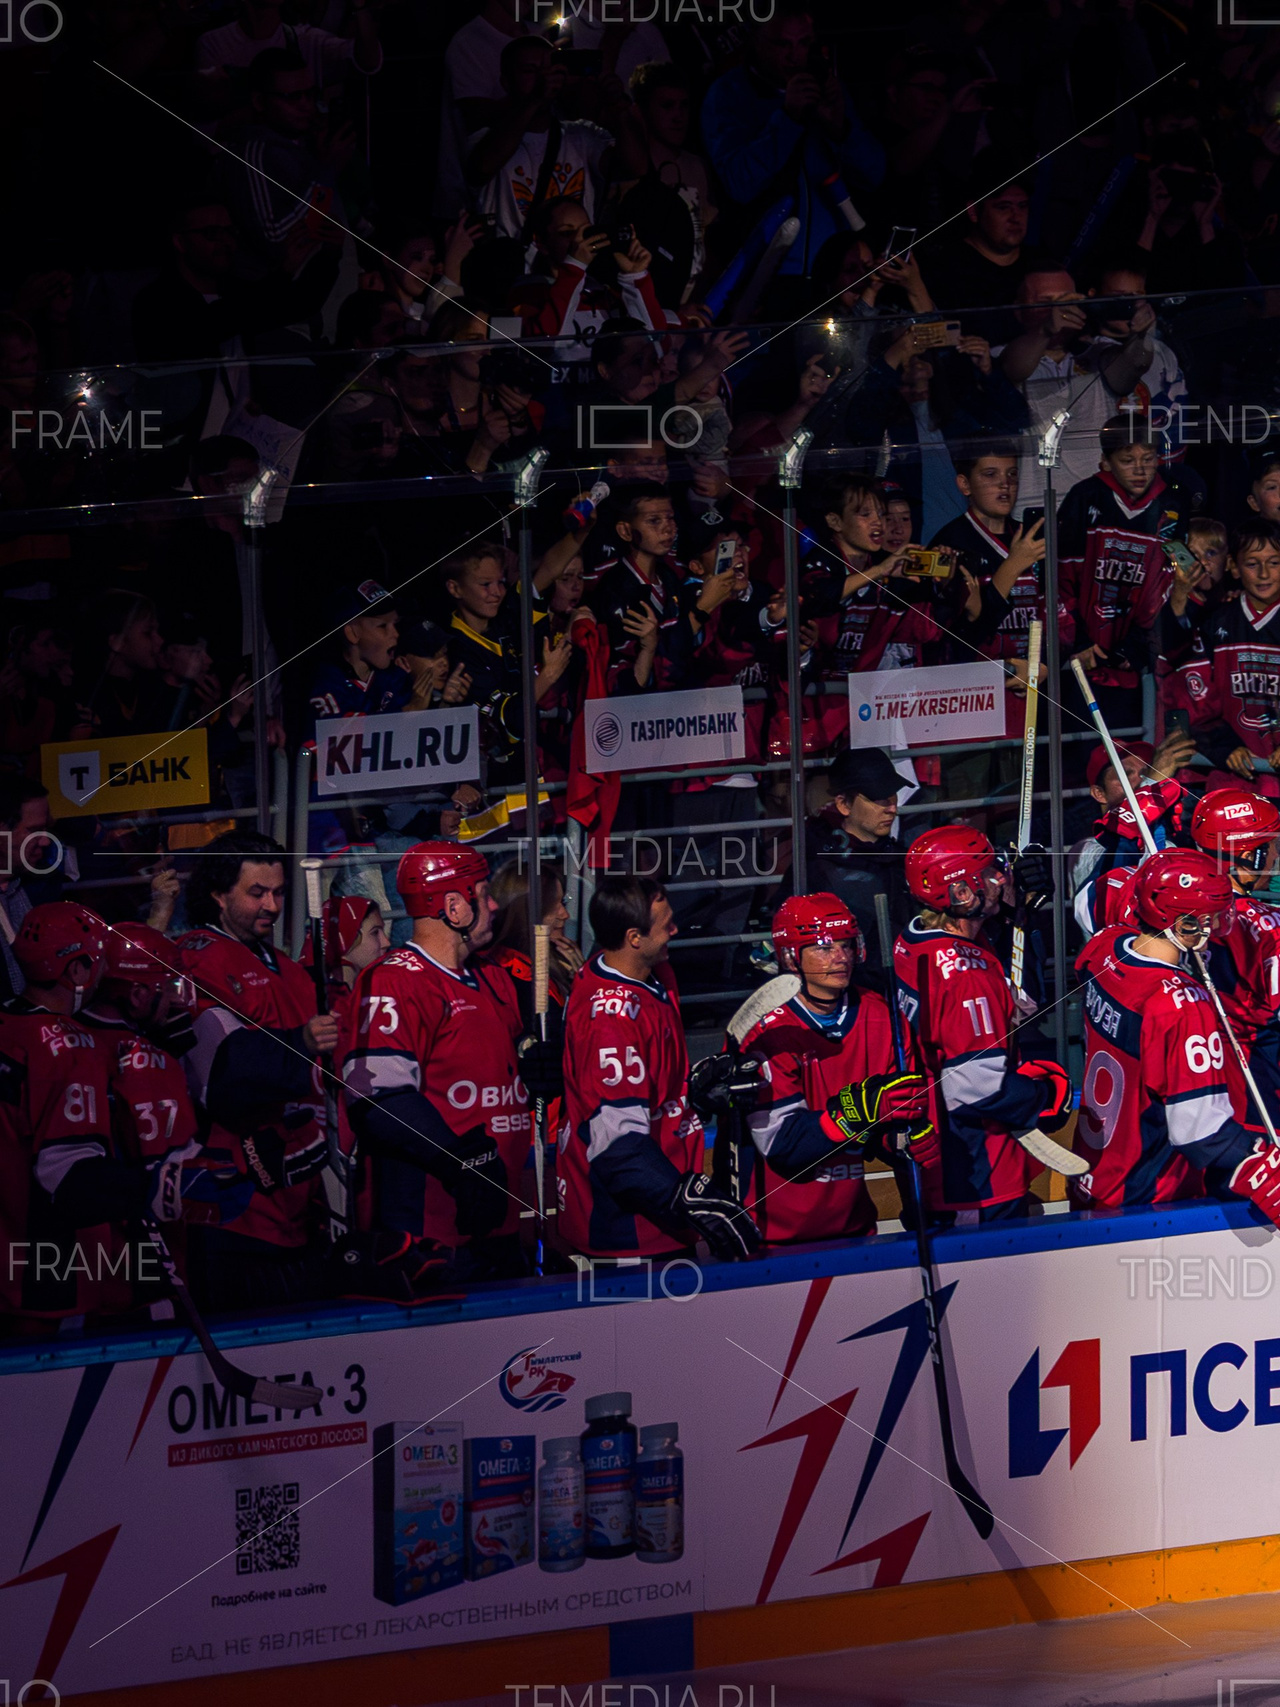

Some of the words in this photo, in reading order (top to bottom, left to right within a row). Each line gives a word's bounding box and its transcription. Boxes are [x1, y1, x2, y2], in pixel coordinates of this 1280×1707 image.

[875, 693, 995, 720] T.ME/KRSCHINA
[631, 712, 738, 742] ГАЗПРОМБАНК
[325, 723, 471, 776] KHL.RU
[109, 756, 191, 787] БАНК
[826, 919, 850, 928] CCM
[941, 956, 988, 981] FON
[360, 995, 399, 1036] 73
[591, 998, 641, 1021] FON
[962, 996, 995, 1038] 11
[49, 1031, 95, 1057] FON
[1184, 1030, 1225, 1074] 69
[118, 1051, 166, 1075] FON
[599, 1045, 647, 1087] 55
[63, 1082, 97, 1125] 81
[134, 1098, 179, 1141] 37
[490, 1113, 532, 1134] 895
[171, 1450, 186, 1463] ИЗ
[189, 1443, 235, 1462] ДИКОГО
[237, 1433, 318, 1455] КАМЧАТСКОГО
[321, 1426, 365, 1445] ЛОСОСЯ
[211, 1590, 276, 1608] Подробнее
[278, 1588, 292, 1598] на
[295, 1582, 327, 1597] сайте
[224, 1638, 250, 1657] НЕ
[259, 1622, 367, 1651] ЯВЛЯЕТСЯ
[372, 1599, 559, 1636] ЛЕКАРСТВЕННЫМ
[565, 1580, 692, 1611] СРЕДСТВОМ
